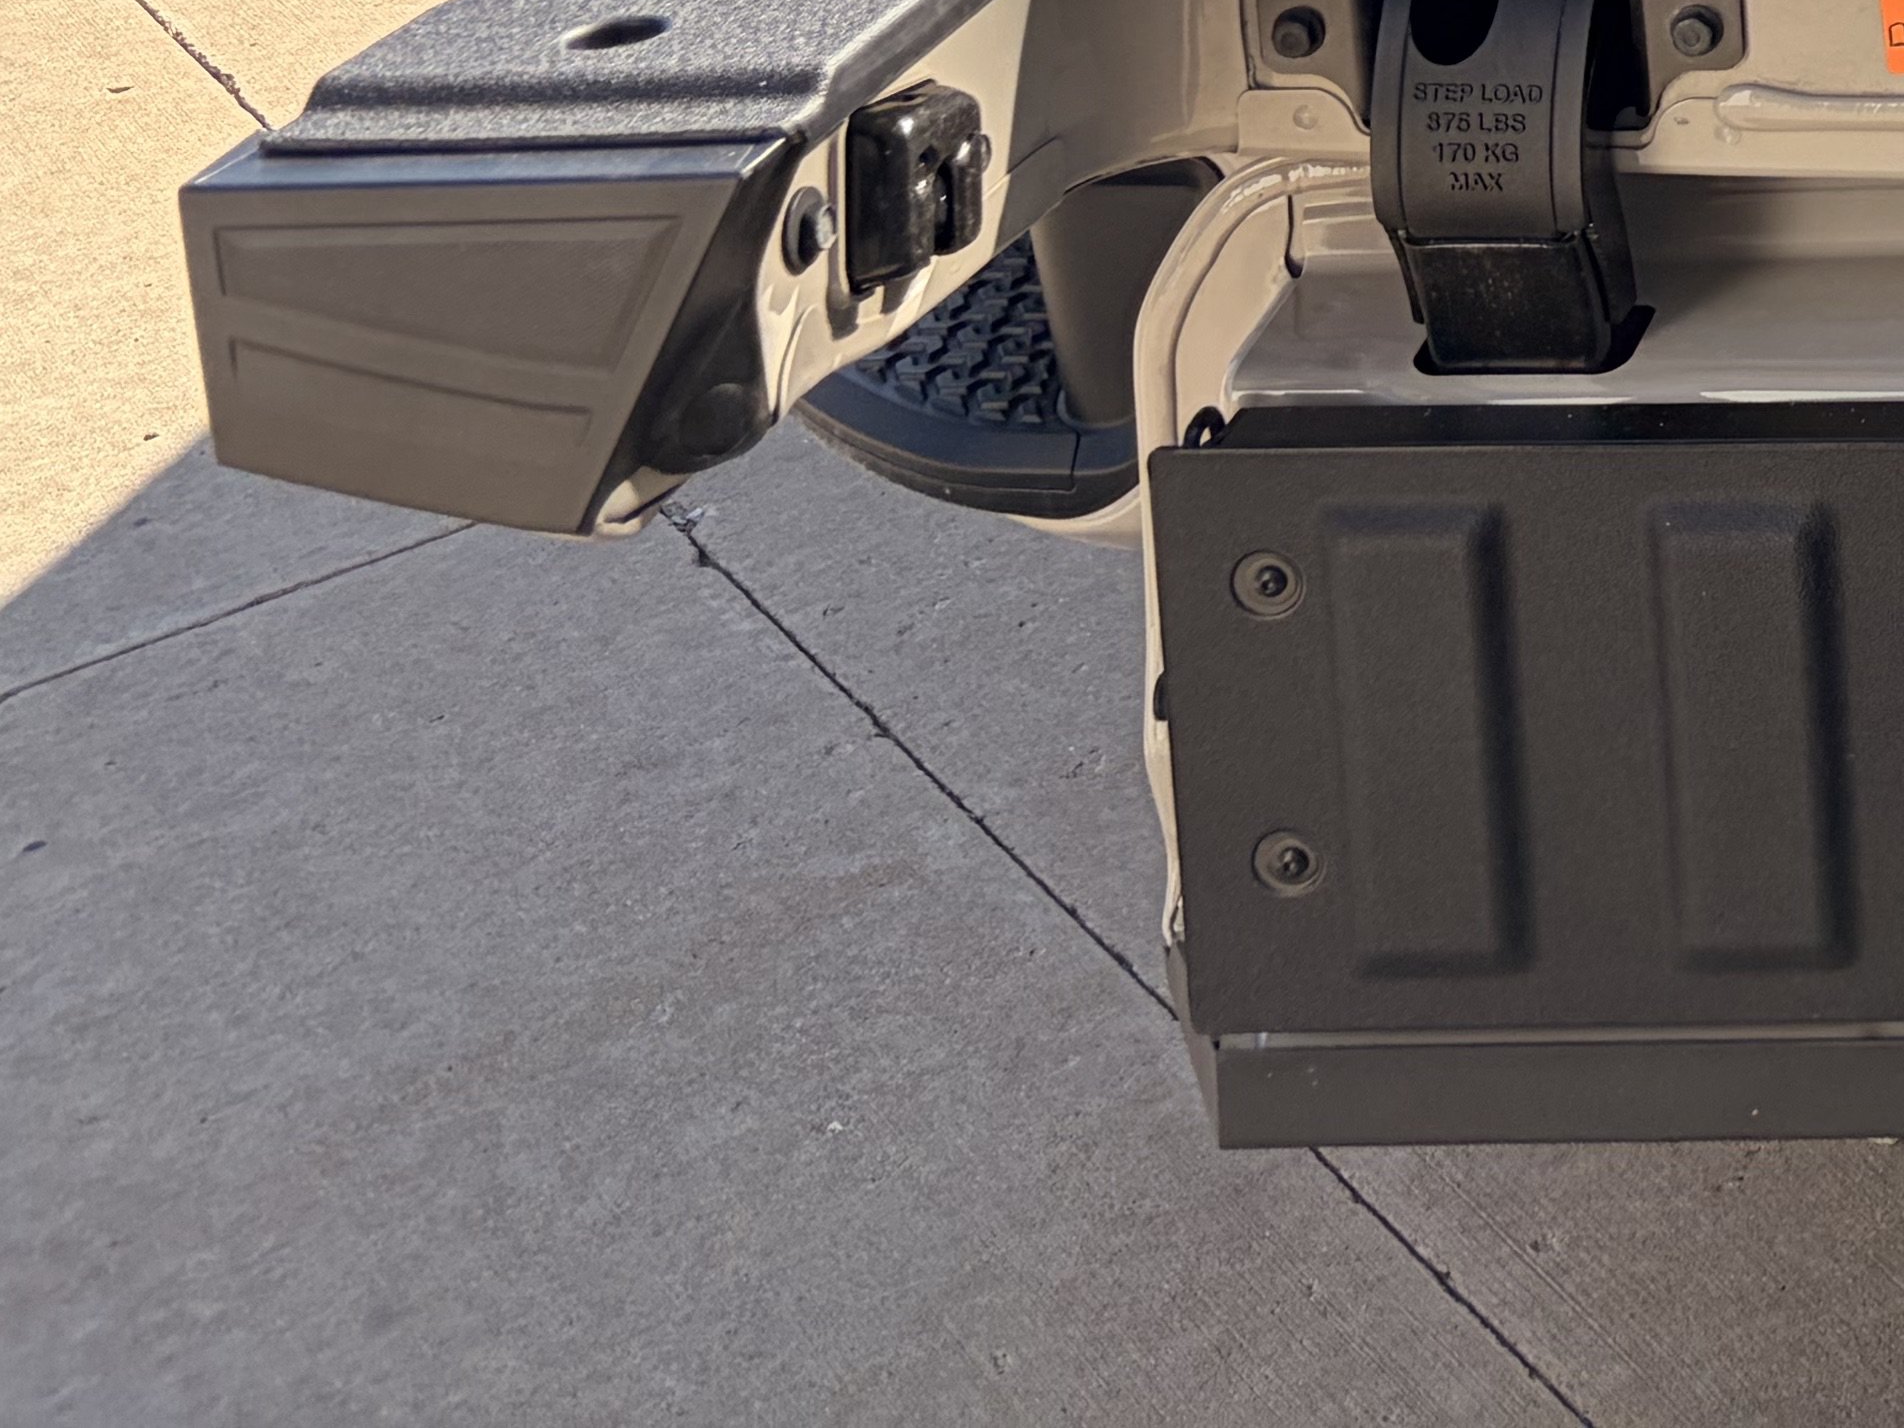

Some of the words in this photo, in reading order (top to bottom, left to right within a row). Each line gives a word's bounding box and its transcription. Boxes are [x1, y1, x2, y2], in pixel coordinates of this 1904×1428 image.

[1413, 82, 1474, 103] STEP
[1481, 83, 1543, 104] LOAD
[1478, 112, 1527, 134] LBS
[1433, 142, 1476, 163] 170
[1484, 143, 1519, 163] KG
[1449, 172, 1503, 192] MAX
